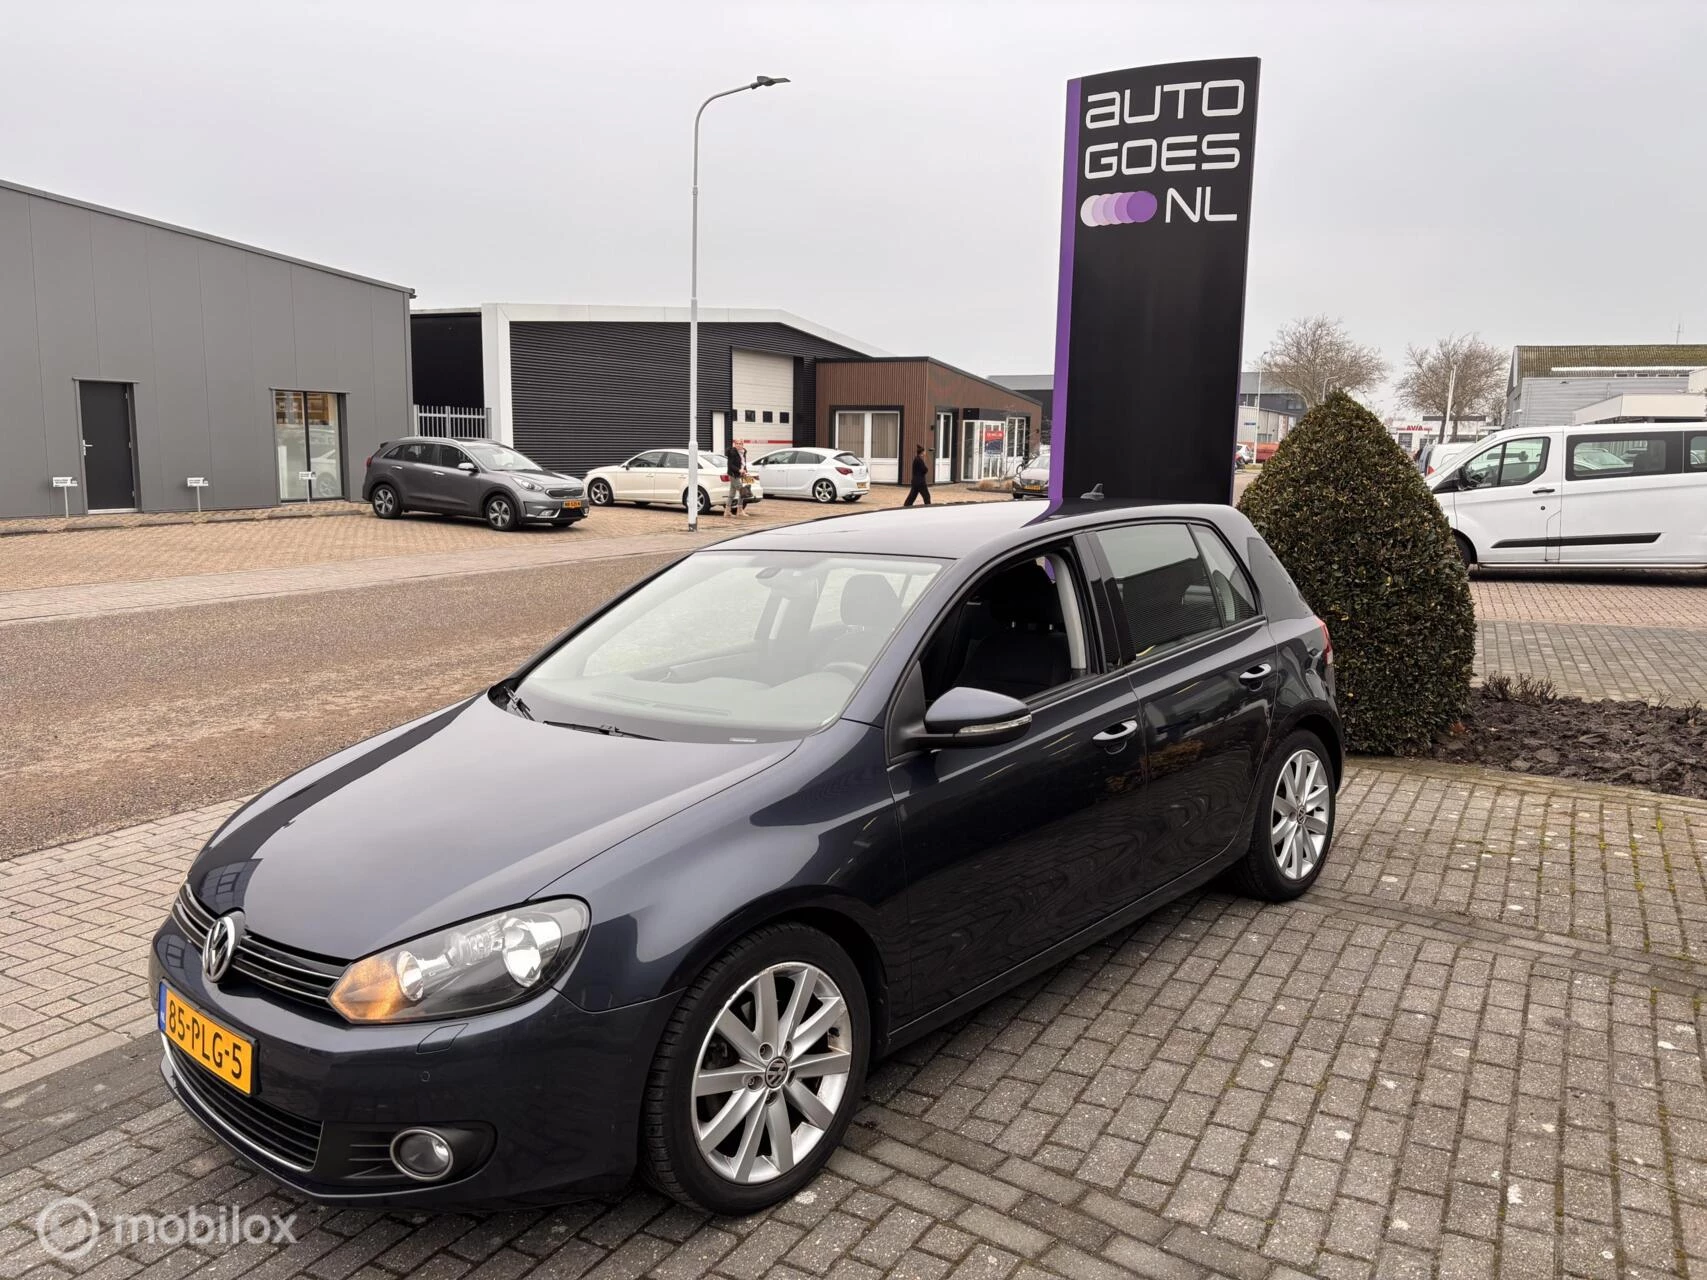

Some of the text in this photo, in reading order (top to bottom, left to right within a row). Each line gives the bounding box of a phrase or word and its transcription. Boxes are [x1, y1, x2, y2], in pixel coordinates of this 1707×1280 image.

[1085, 133, 1240, 179] GOES
[1165, 186, 1238, 223] NL
[168, 1000, 242, 1080] 85-PLG-5
